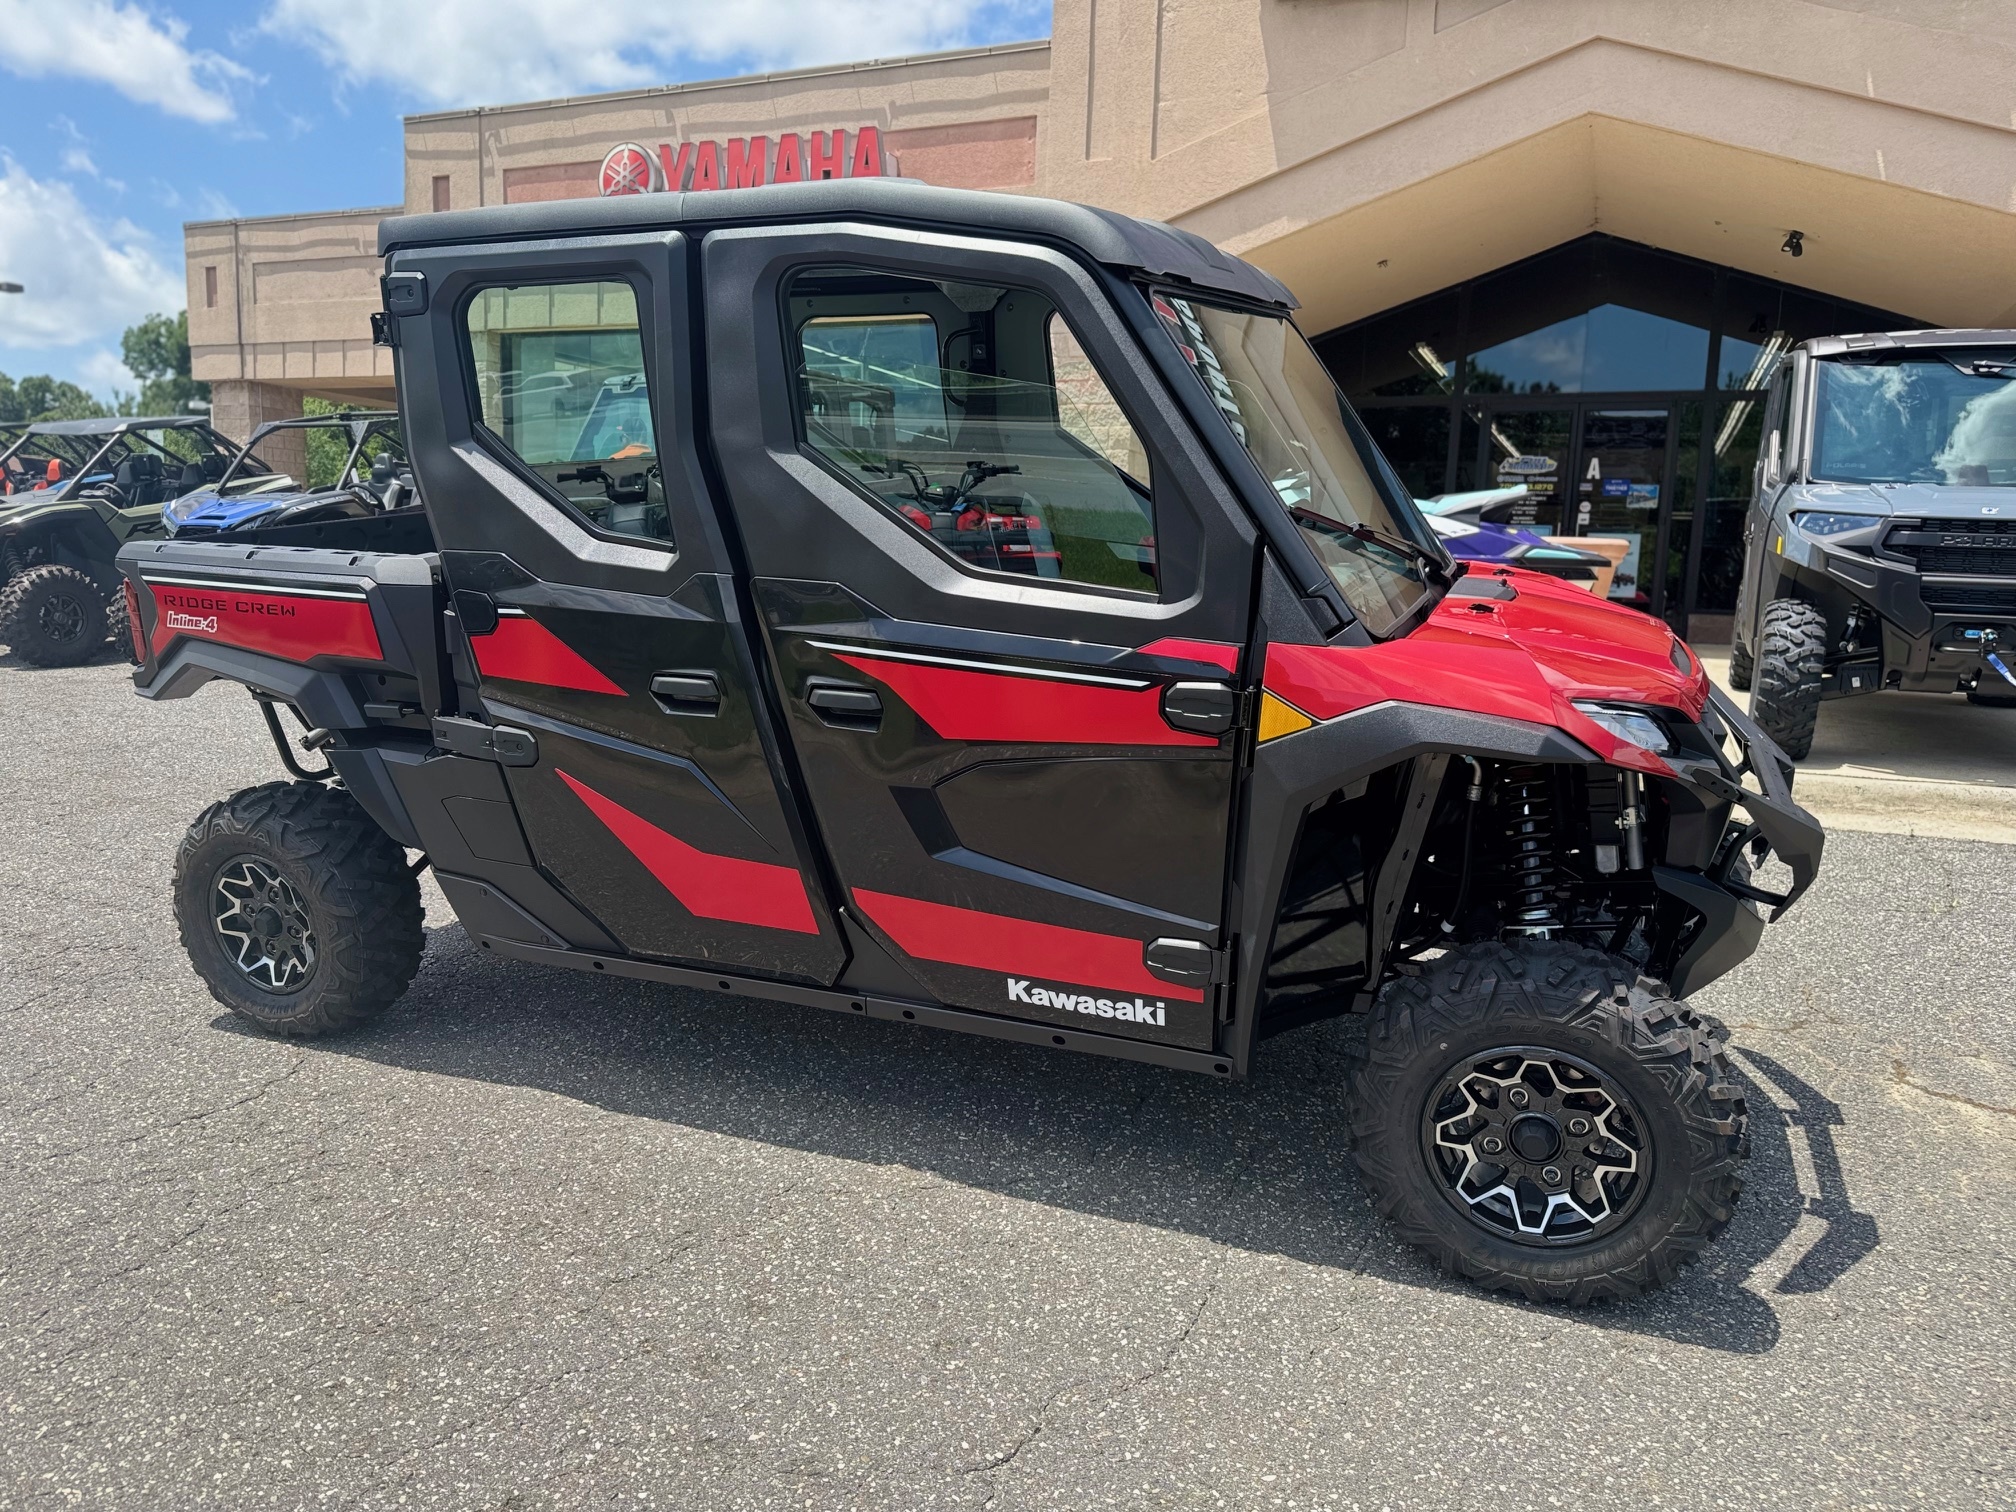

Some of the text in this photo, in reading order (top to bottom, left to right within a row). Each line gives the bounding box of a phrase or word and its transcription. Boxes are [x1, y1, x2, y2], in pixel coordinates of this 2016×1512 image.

[659, 126, 883, 192] YAMAHA
[1586, 457, 1601, 480] A
[164, 594, 295, 617] RIDGE CREW
[167, 611, 217, 633] Inline-4
[1007, 978, 1166, 1026] Kawasaki
